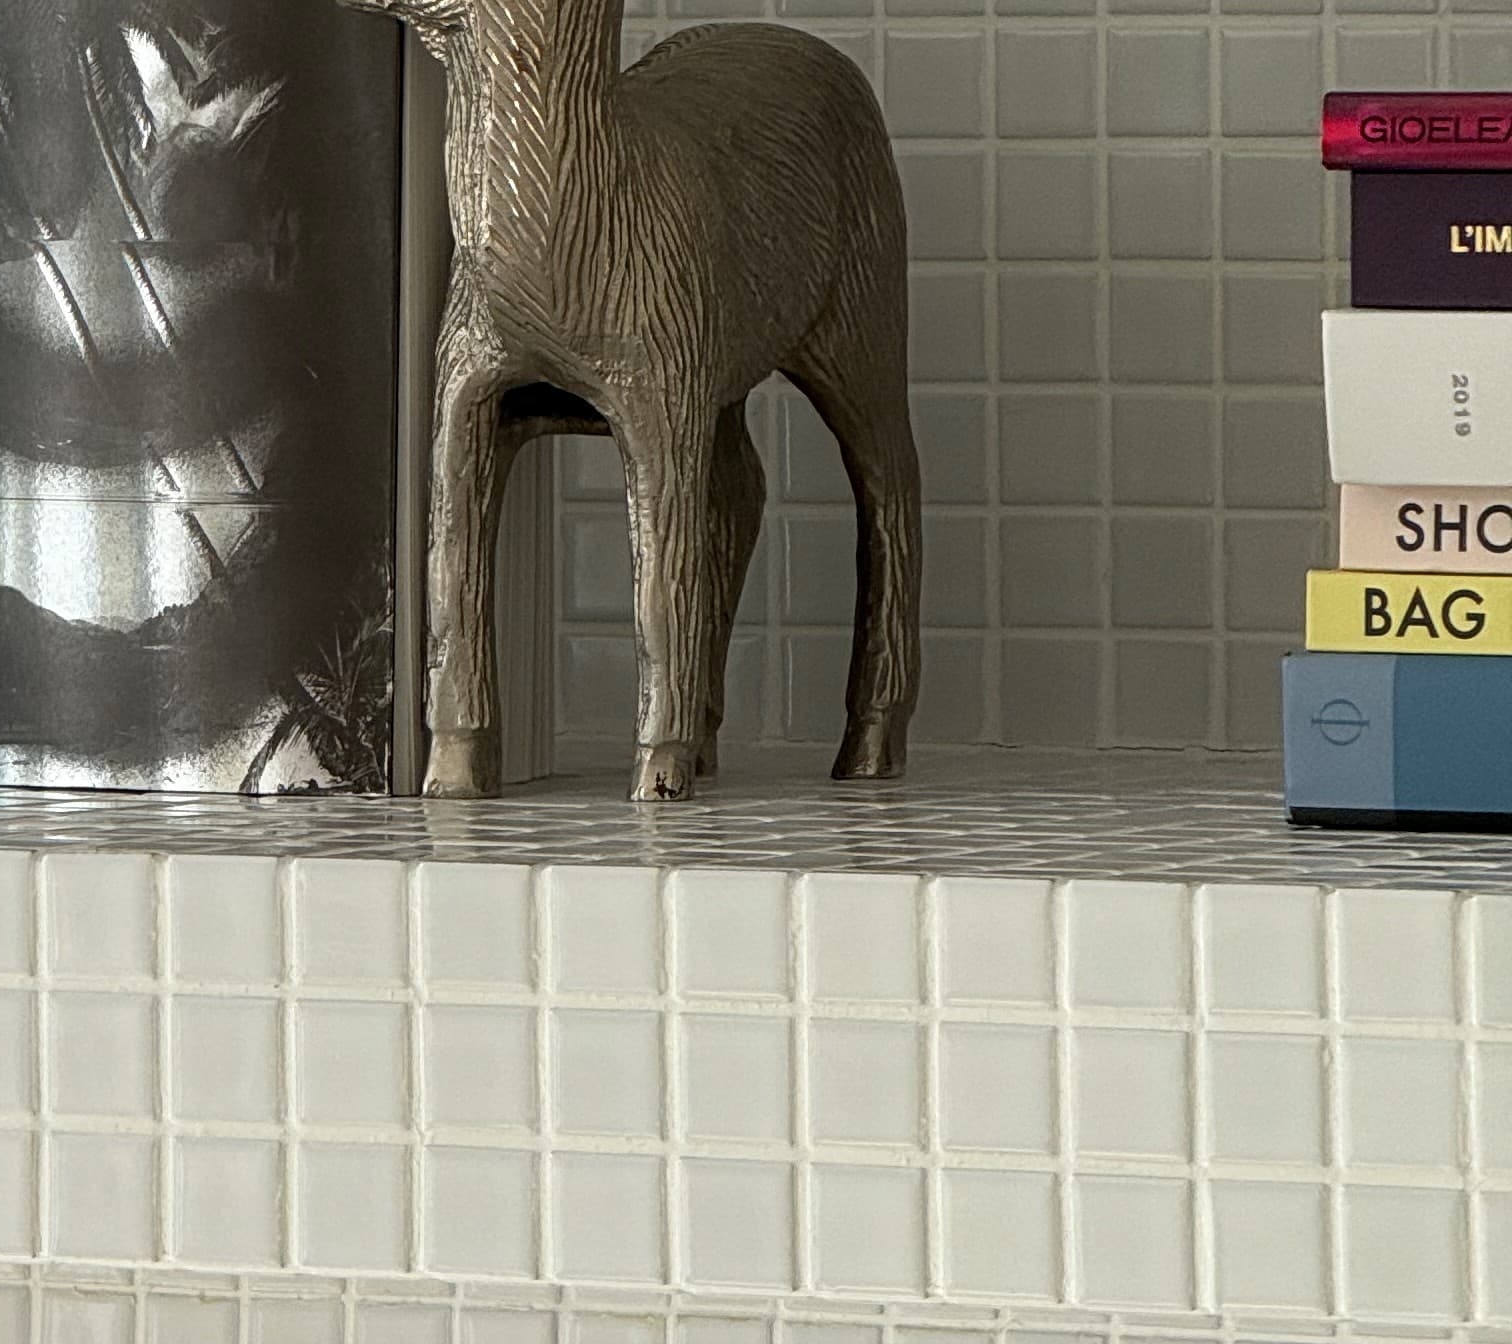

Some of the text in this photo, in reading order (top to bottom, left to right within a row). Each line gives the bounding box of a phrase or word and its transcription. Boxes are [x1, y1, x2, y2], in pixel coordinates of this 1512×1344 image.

[1360, 116, 1512, 143] GIOELE
[1452, 374, 1472, 437] 2019
[1395, 502, 1512, 554] SHO
[1364, 586, 1487, 640] BAG
